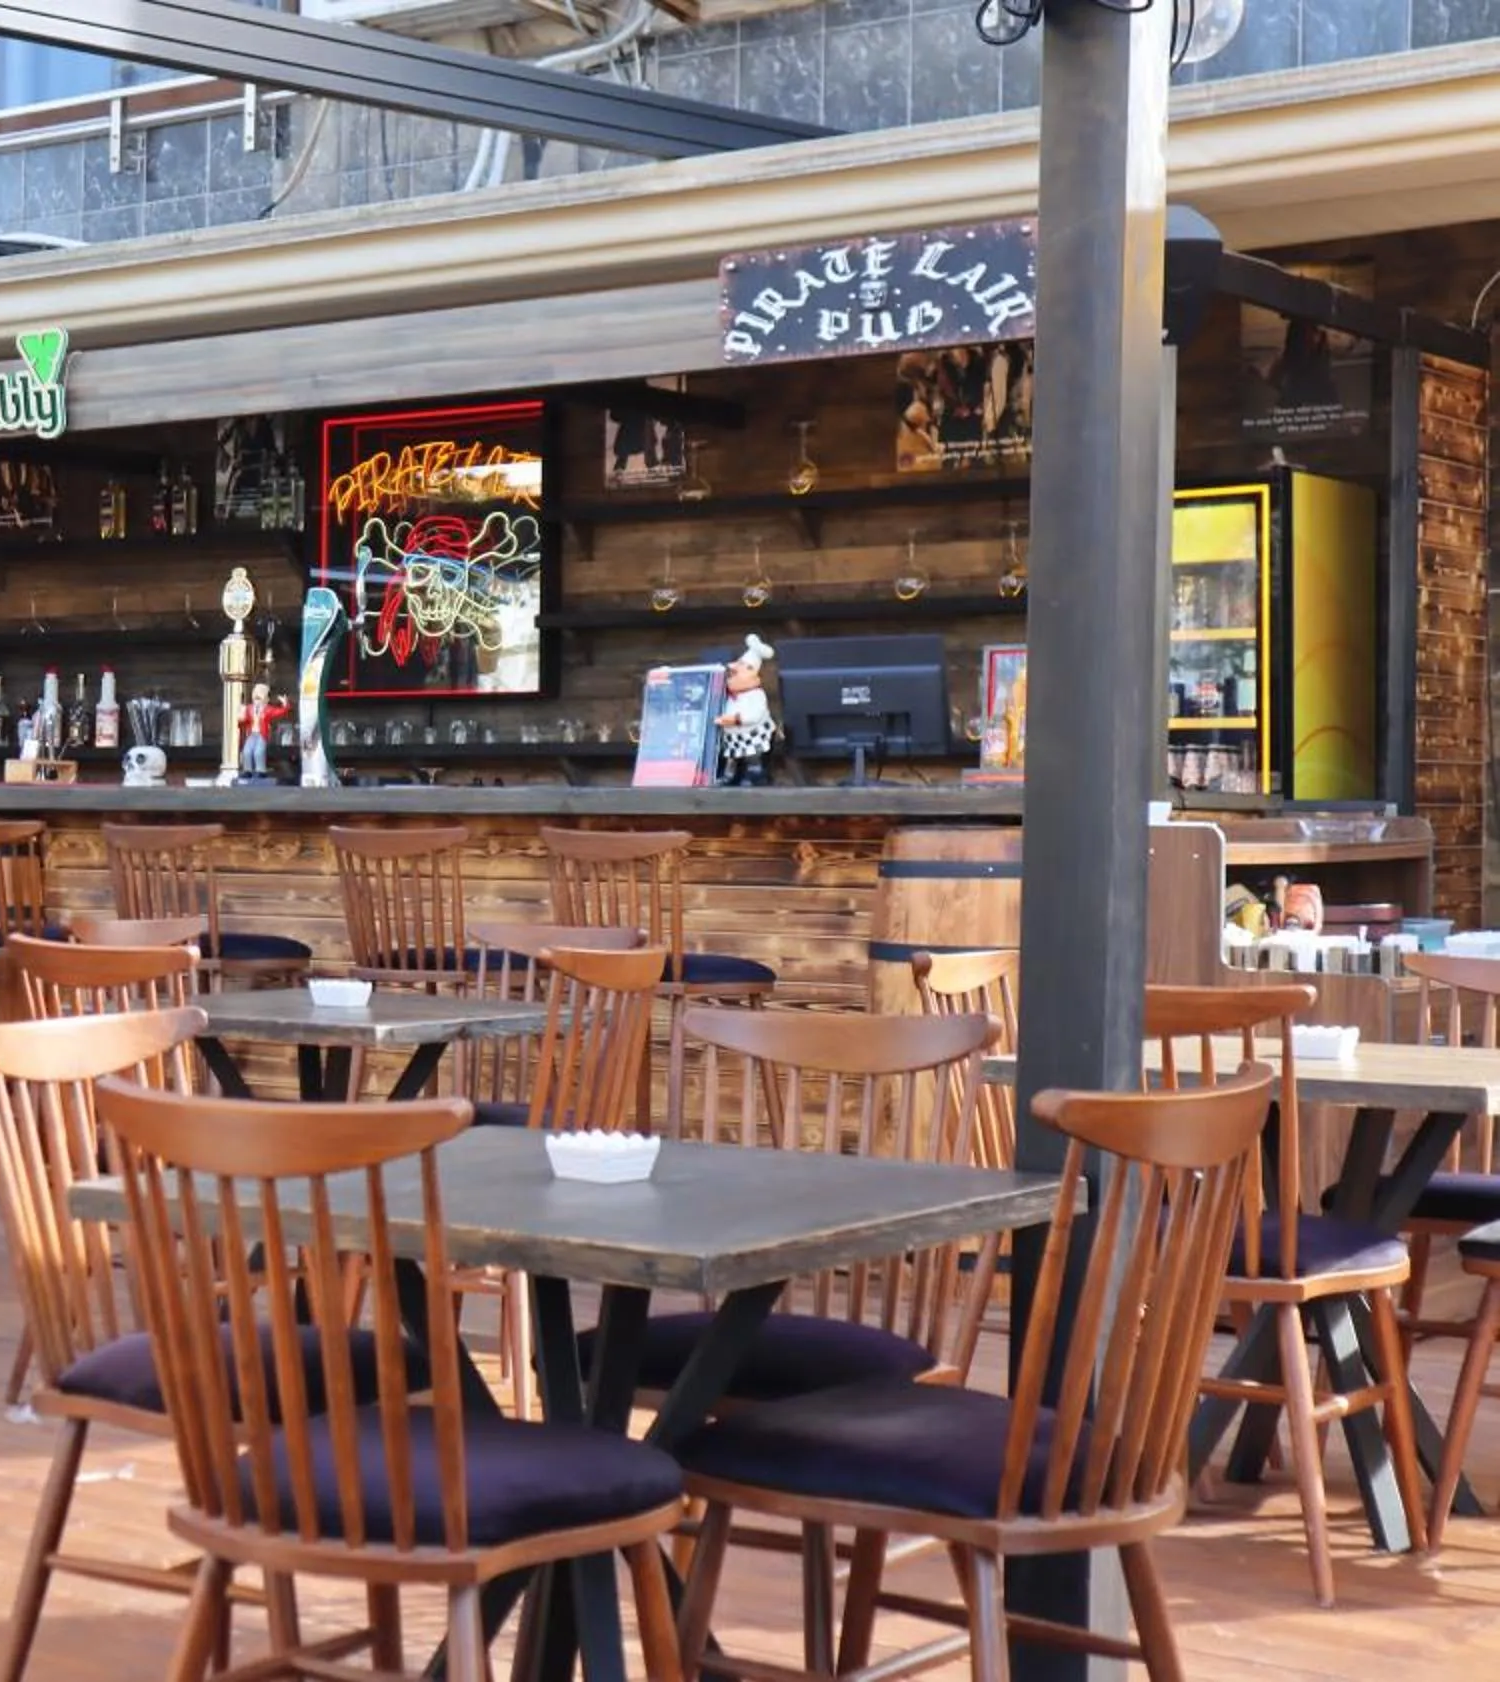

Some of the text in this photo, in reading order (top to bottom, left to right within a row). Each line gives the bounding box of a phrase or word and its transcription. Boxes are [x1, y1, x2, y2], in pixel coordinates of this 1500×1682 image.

[725, 239, 1034, 357] PIRATE LAIR
[817, 300, 943, 345] PUB
[329, 440, 457, 526] PIRATE
